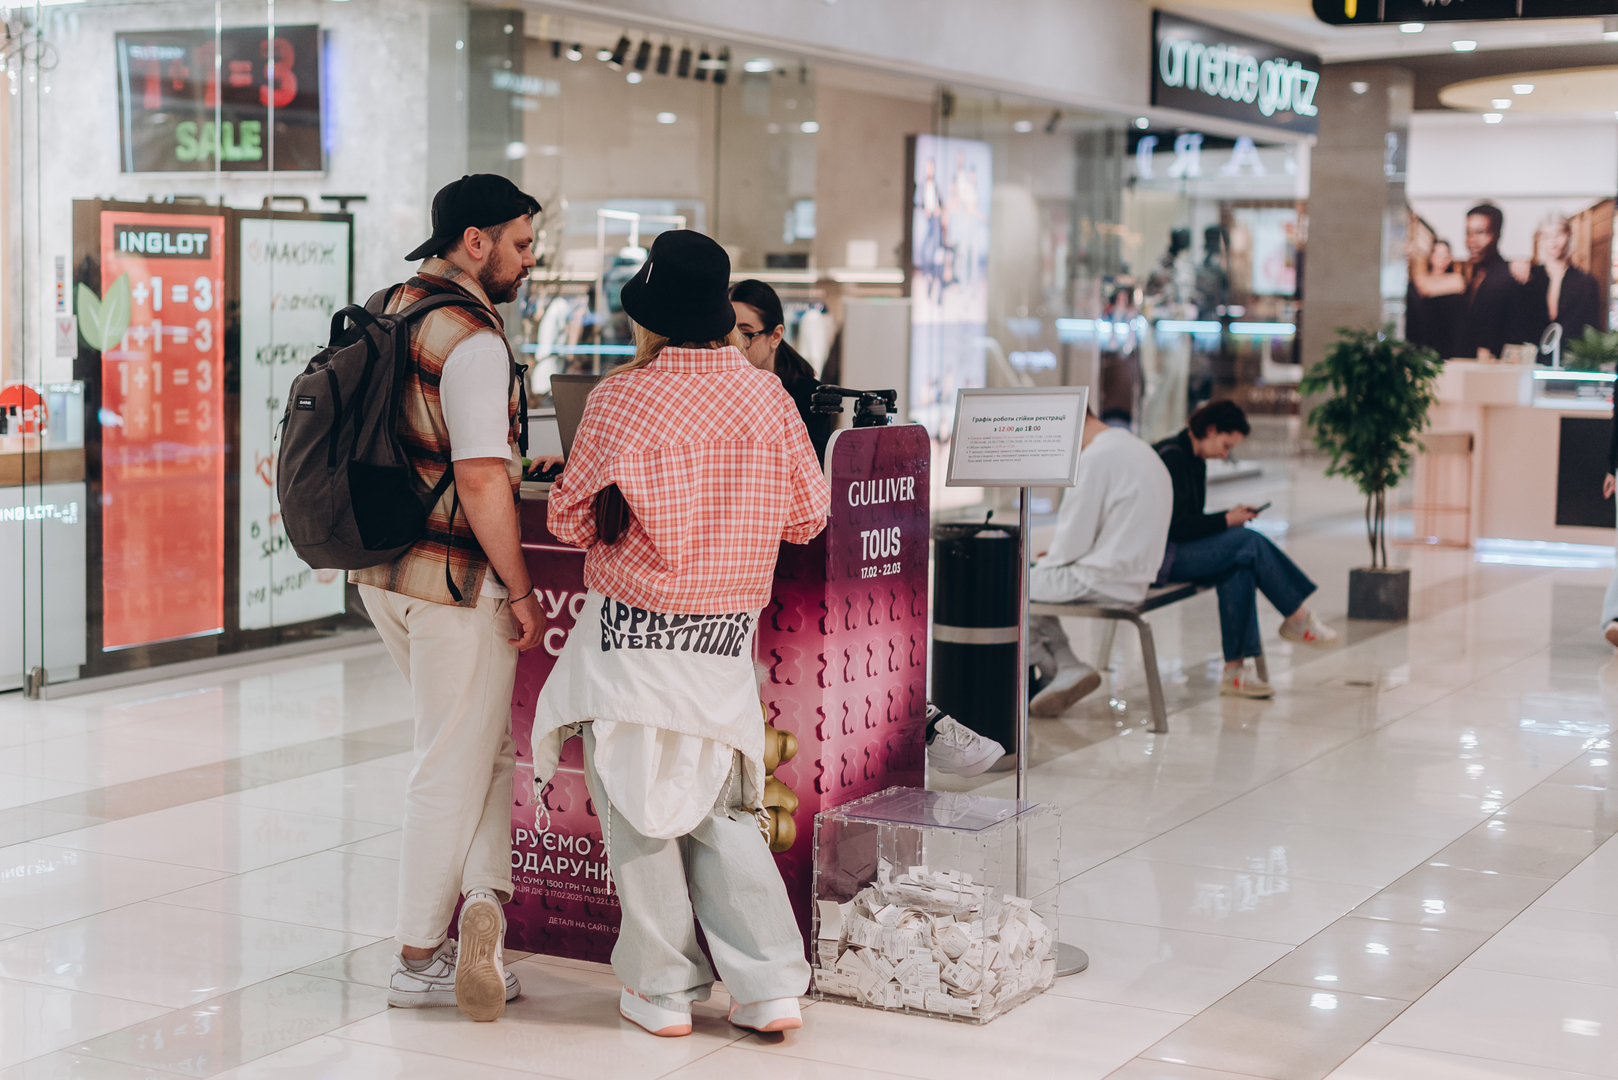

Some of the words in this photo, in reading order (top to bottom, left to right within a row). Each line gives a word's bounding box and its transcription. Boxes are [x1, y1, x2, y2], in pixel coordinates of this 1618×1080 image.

[175, 120, 262, 162] SALE
[119, 231, 208, 255] INGLOT
[993, 415, 1014, 423] роботи
[848, 476, 915, 507] GULLIVER
[860, 526, 901, 561] TOUS
[861, 566, 877, 579] 17.02
[883, 561, 901, 576] 22.03
[600, 619, 746, 657] EVERYTHING
[511, 828, 591, 856] РУЄМО
[511, 850, 614, 882] ОДАРУНК
[514, 885, 530, 893] КЦІЯ
[531, 887, 544, 896] ДІЄ
[551, 890, 583, 902] 17.02.2025
[584, 895, 595, 903] ПО
[522, 876, 545, 886] СУМУ
[546, 879, 564, 889] 1500
[565, 882, 580, 891] ГРН
[581, 884, 591, 893] ТА
[548, 917, 574, 927] ДЕТАЛІ
[575, 920, 586, 929] НА
